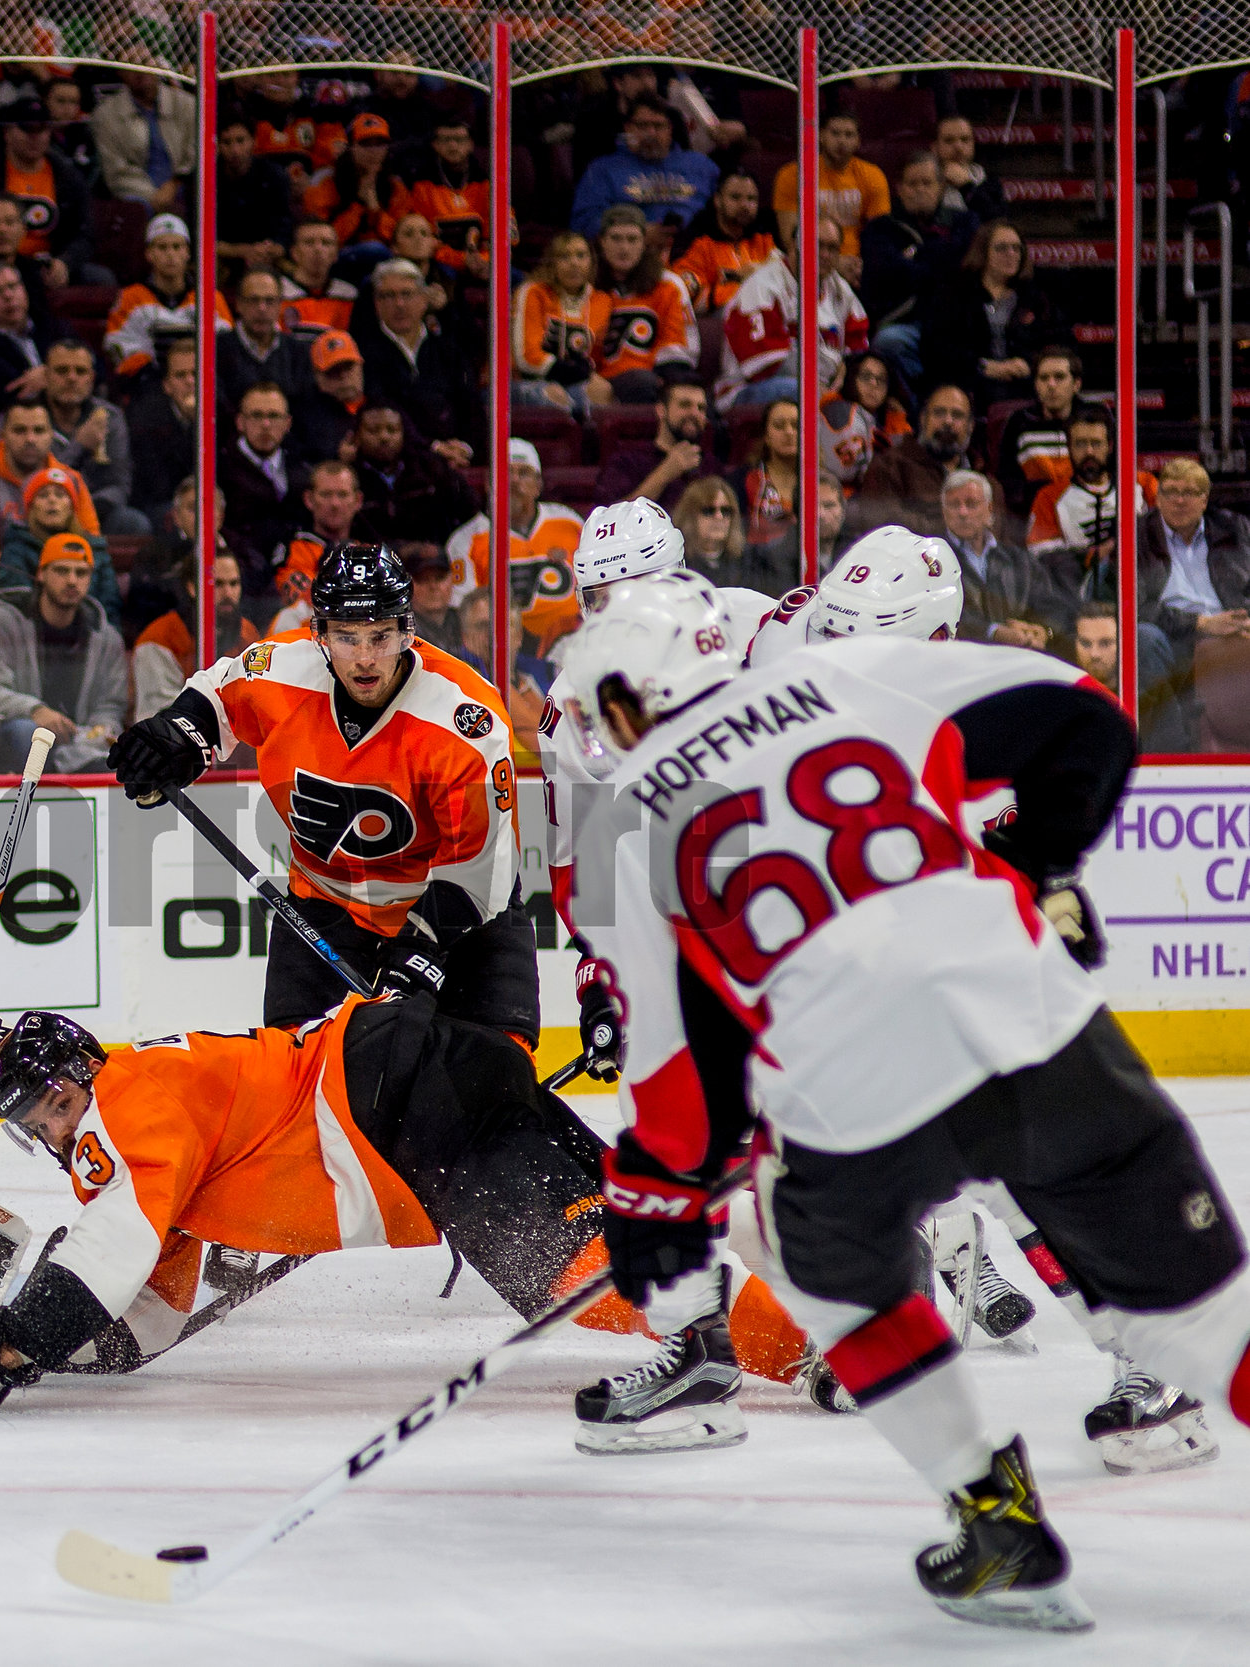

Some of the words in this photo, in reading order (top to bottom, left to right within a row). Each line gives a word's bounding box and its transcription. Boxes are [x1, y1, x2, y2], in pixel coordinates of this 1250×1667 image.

[352, 564, 367, 581] 9
[593, 552, 628, 568] BAUER
[843, 563, 871, 585] 19
[826, 602, 861, 618] BAUER
[695, 623, 726, 656] 68
[631, 679, 838, 822] HOFFMAN
[491, 757, 514, 814] 9
[1115, 804, 1250, 850] HOCK
[0, 836, 14, 877] BAUER
[675, 736, 969, 987] 68
[272, 896, 321, 942] NEXUS
[0, 1088, 22, 1113] CCM
[75, 1131, 116, 1186] 3
[346, 1357, 487, 1480] CCM
